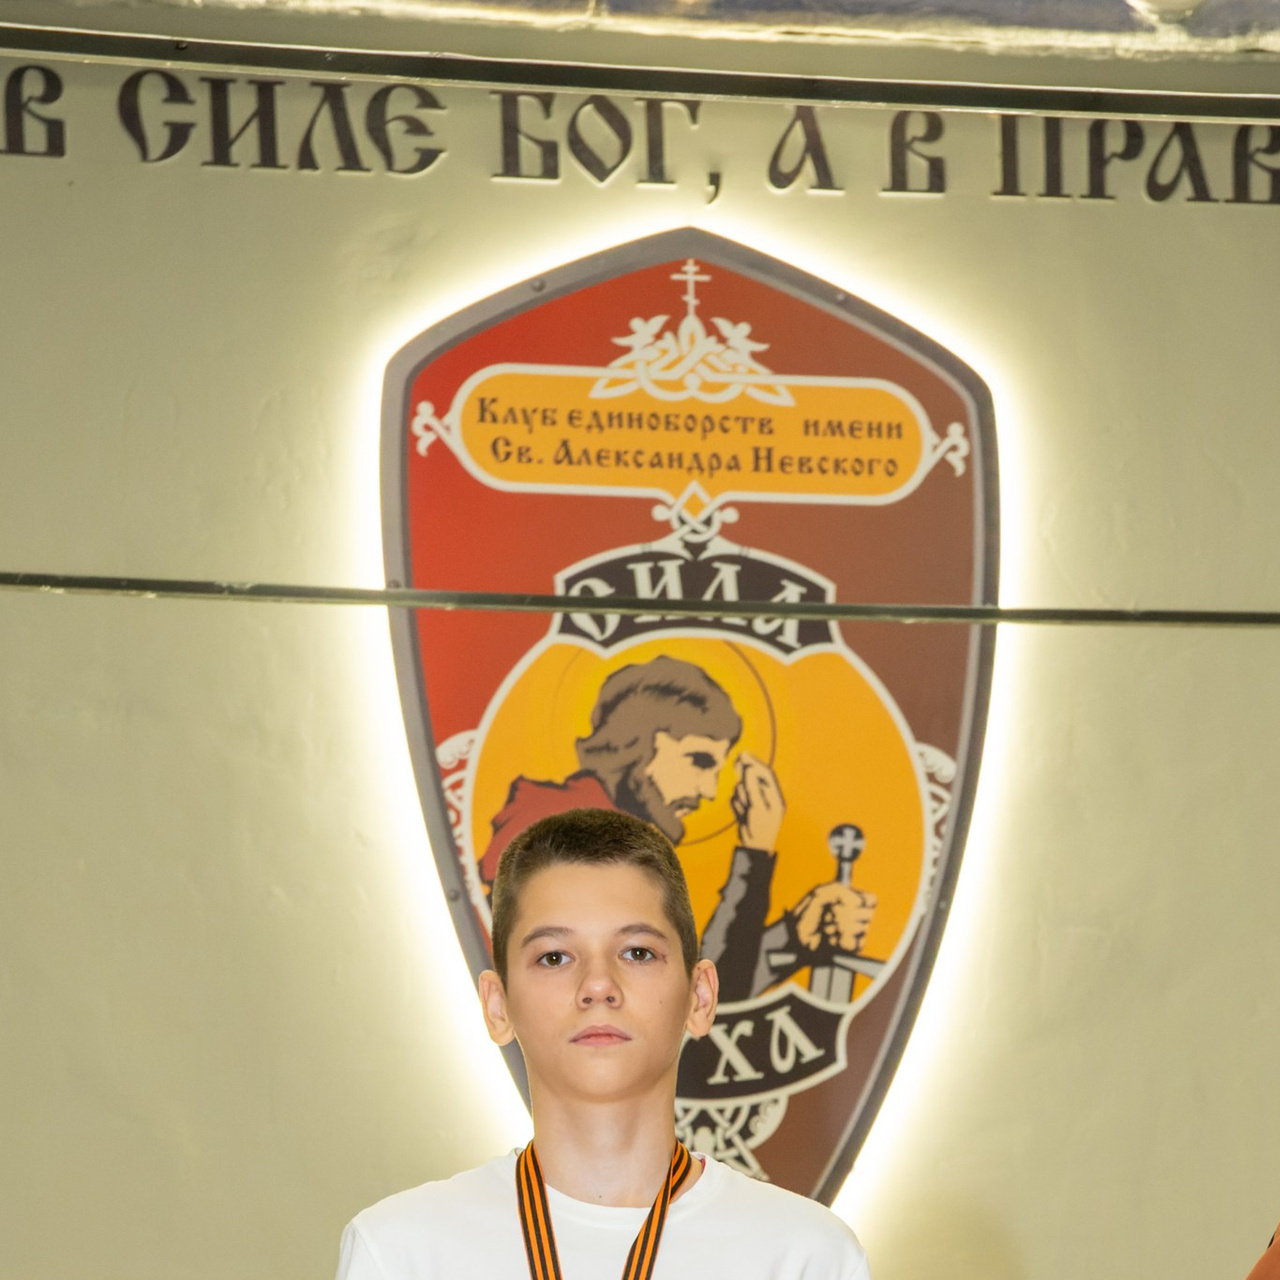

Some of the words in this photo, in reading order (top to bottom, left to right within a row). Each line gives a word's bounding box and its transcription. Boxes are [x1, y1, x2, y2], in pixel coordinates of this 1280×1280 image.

[0, 65, 66, 158] В
[118, 69, 449, 176] СИЛЕ
[489, 90, 723, 204] БОГ,
[767, 104, 845, 195] А
[878, 108, 945, 196] В
[477, 397, 557, 434] Клуб
[567, 408, 775, 441] единоборств
[803, 419, 904, 440] имени
[490, 436, 544, 465] Св.
[552, 438, 742, 479] Александра
[752, 446, 899, 478] Невского
[568, 559, 809, 649] СИЛА
[706, 1005, 825, 1086] ХА
